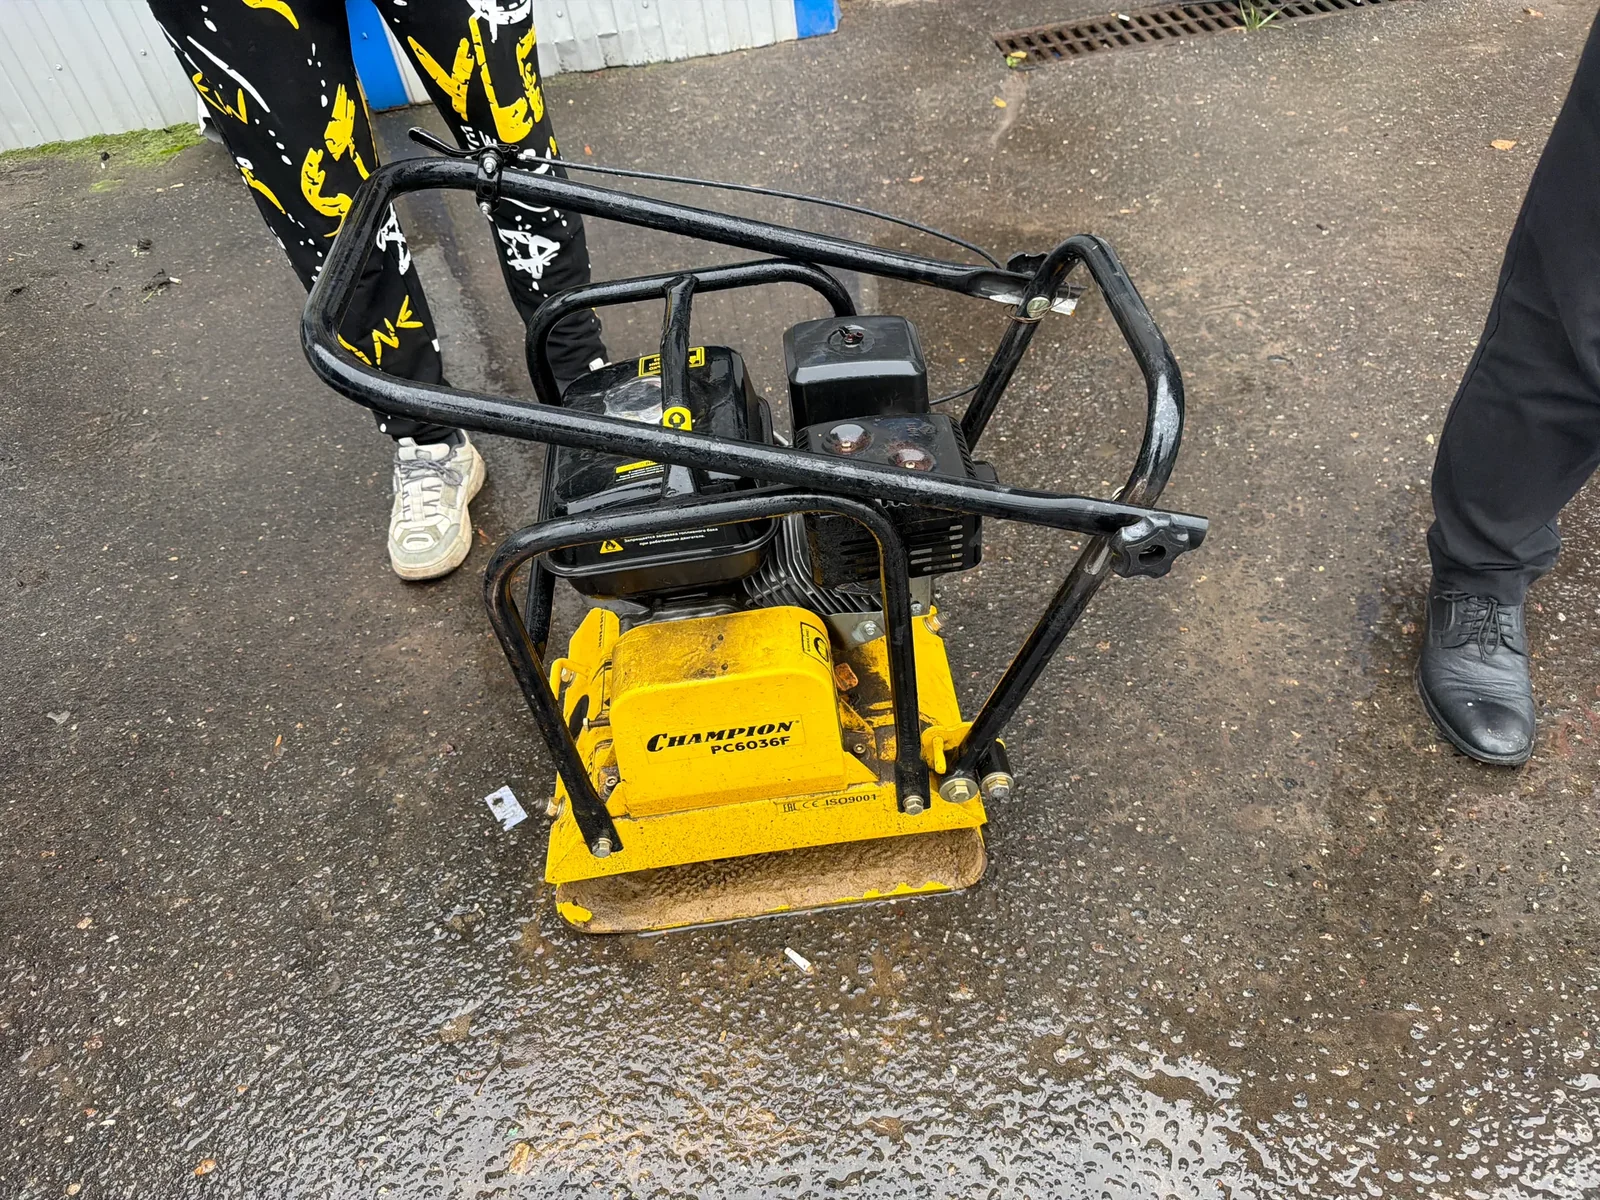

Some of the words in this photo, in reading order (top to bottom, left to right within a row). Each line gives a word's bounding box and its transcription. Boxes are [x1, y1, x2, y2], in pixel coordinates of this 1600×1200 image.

[646, 720, 795, 753] CHAMPION
[710, 736, 791, 755] PC6036F
[825, 793, 877, 807] ISO9001
